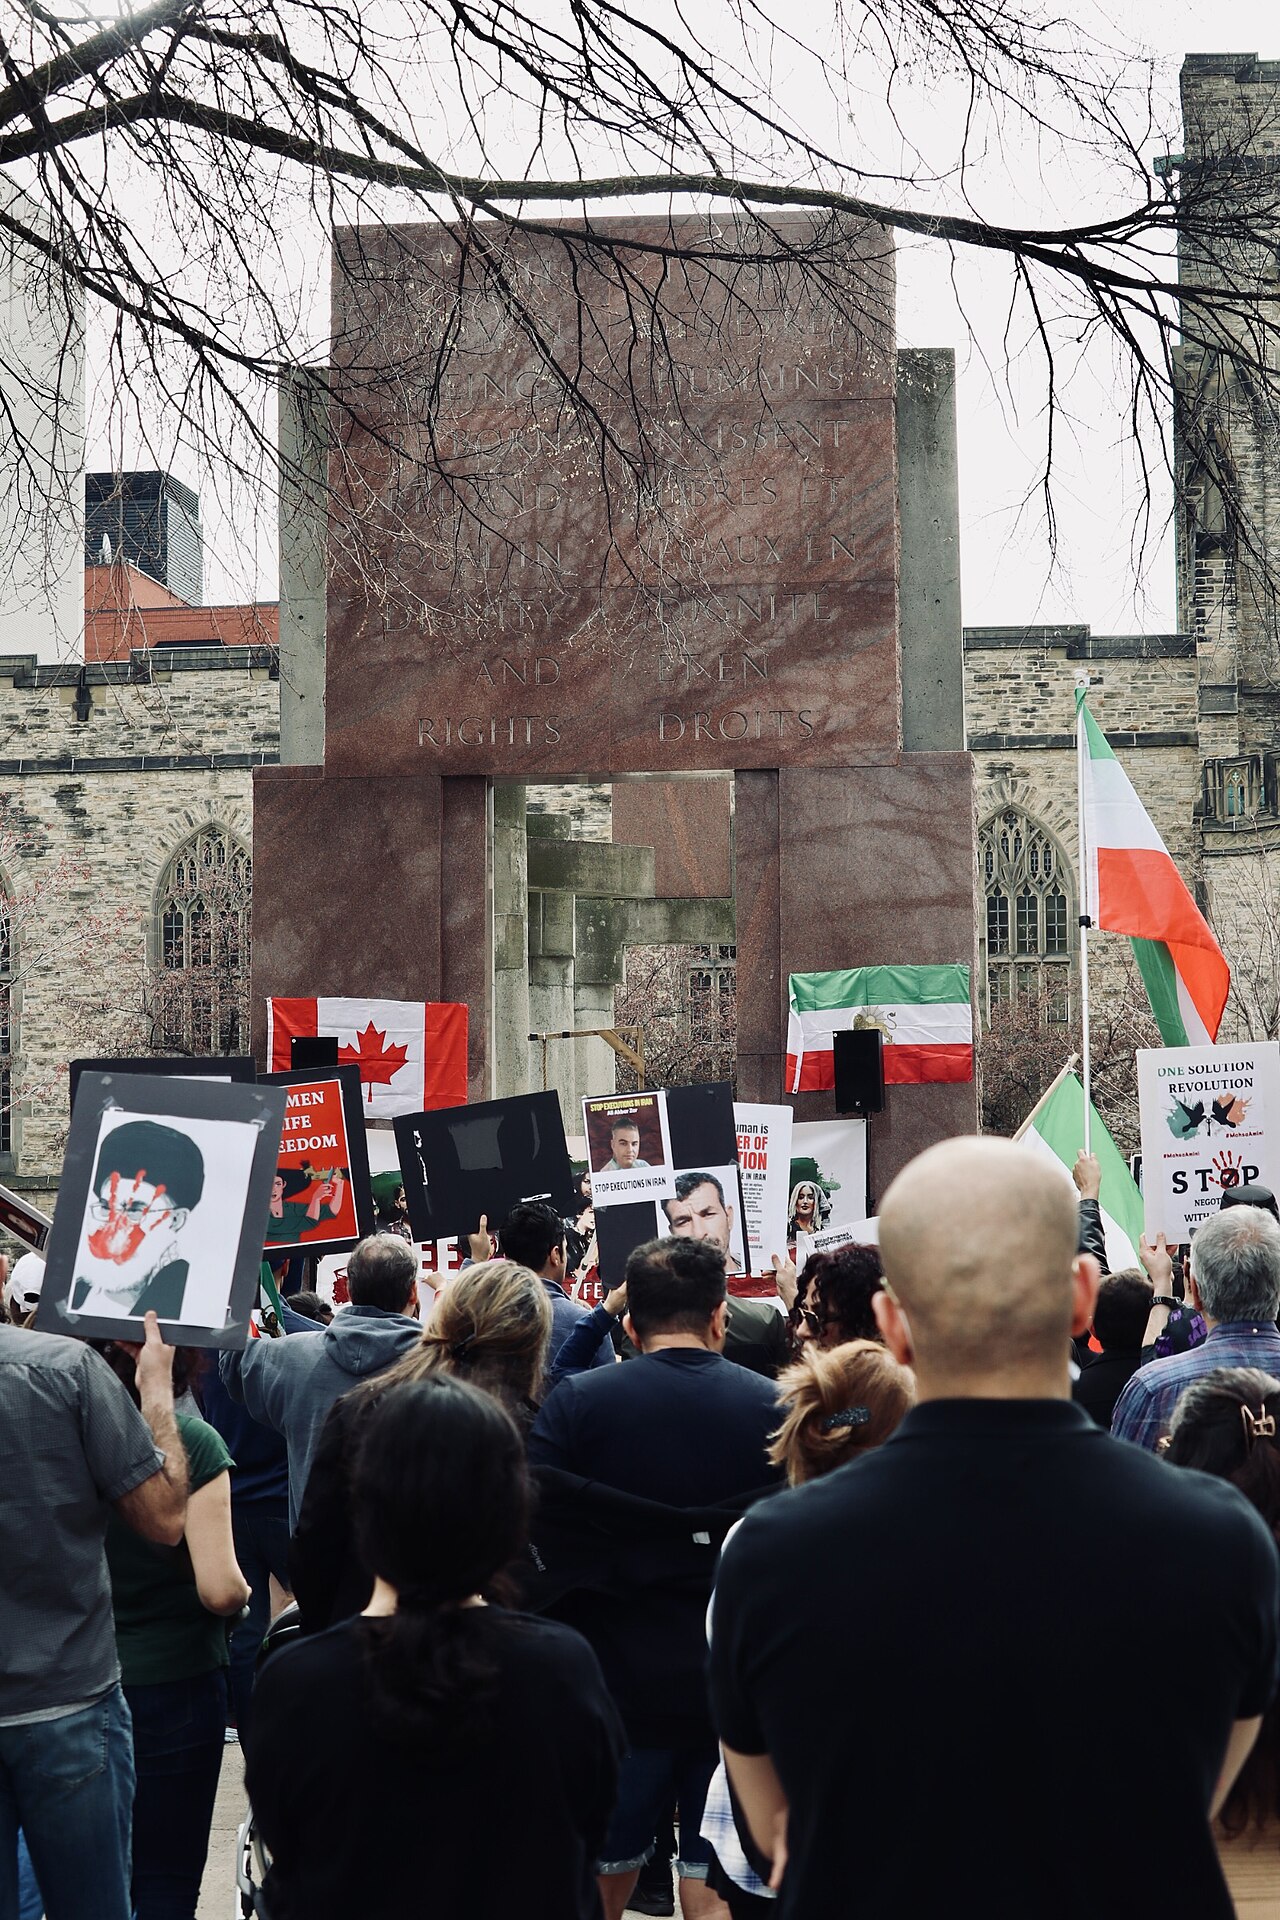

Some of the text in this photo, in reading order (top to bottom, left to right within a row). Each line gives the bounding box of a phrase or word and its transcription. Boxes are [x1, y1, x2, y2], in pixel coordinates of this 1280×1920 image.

[657, 364, 843, 394] HUMAINS
[802, 475, 845, 505] ET
[519, 542, 562, 569] IN
[806, 533, 856, 563] EN
[658, 585, 832, 622] DIGNITÉ
[385, 599, 557, 632] DIGNITY
[474, 656, 561, 687] AND
[658, 653, 769, 684] ET EN
[416, 715, 561, 747] RIGHTS
[658, 710, 815, 743] DROITS
[1158, 1061, 1254, 1077] ONE SOLUTION
[1169, 1078, 1253, 1093] REVOLUTION
[286, 1091, 324, 1108] MEN
[283, 1115, 312, 1131] IFE
[761, 1123, 769, 1134] is
[278, 1134, 338, 1153] EEDOM
[737, 1135, 768, 1150] ER OF
[738, 1151, 768, 1170] TION
[595, 1176, 667, 1193] STOP EXECUTIONS IN IRAN
[752, 1172, 767, 1181] IRAN
[1172, 1165, 1259, 1194] STOP
[1194, 1198, 1222, 1207] NEGOT
